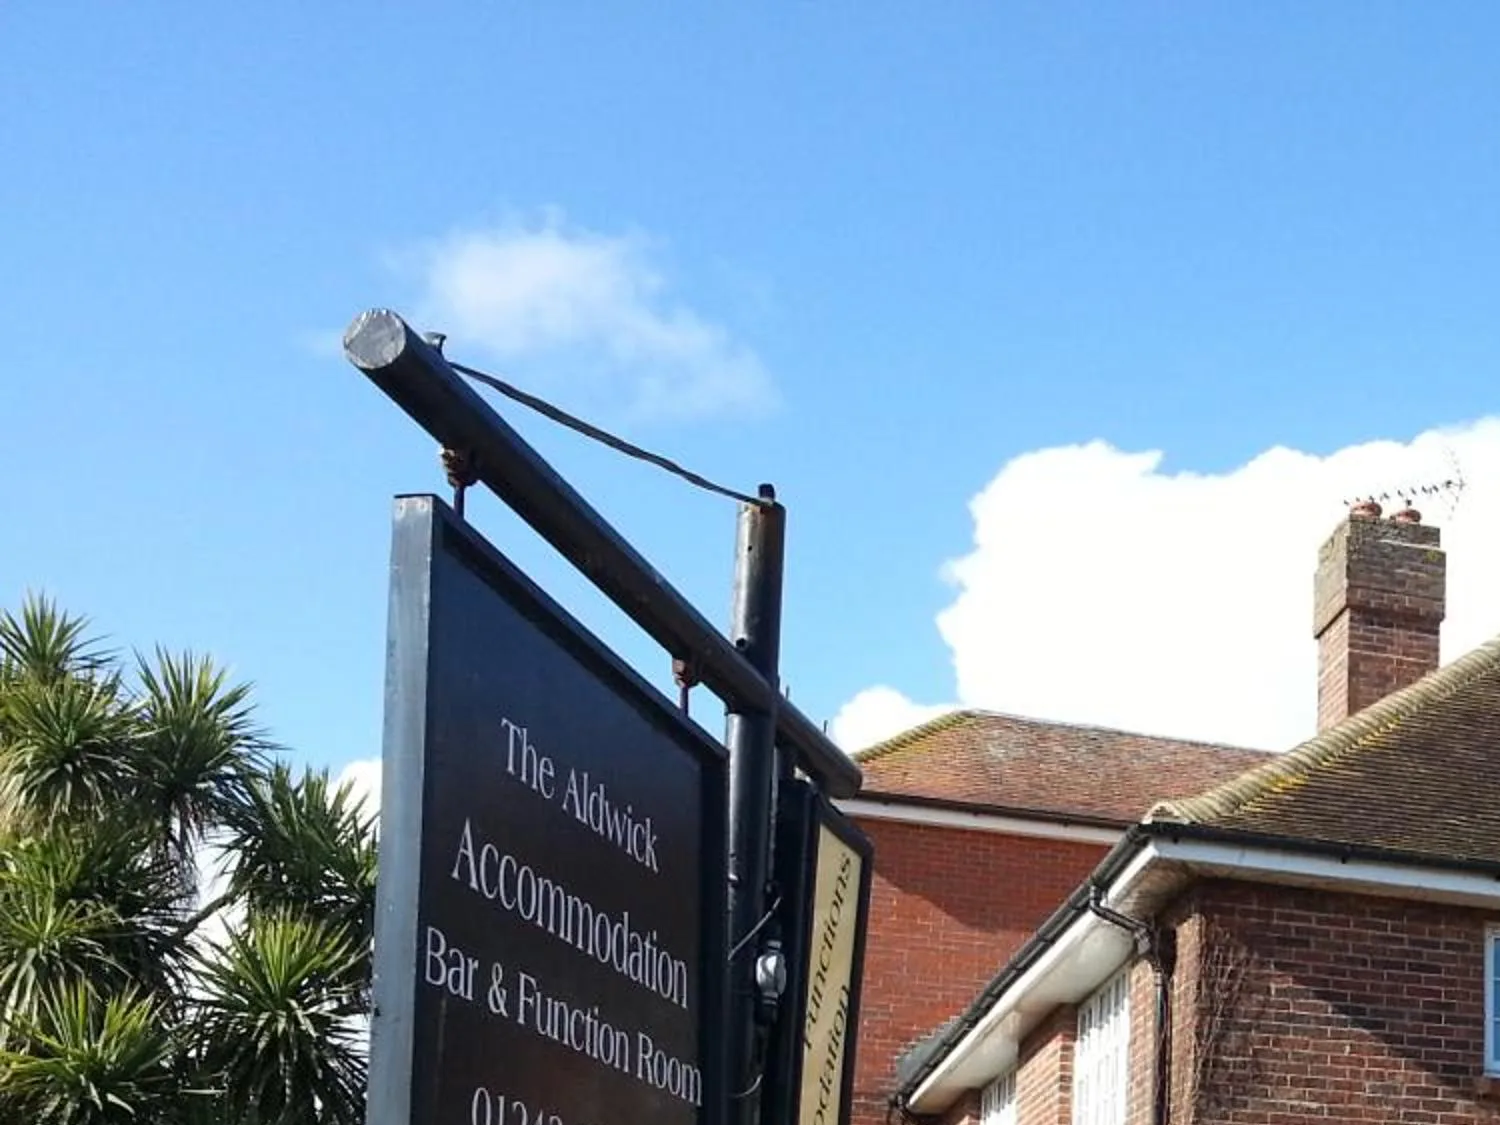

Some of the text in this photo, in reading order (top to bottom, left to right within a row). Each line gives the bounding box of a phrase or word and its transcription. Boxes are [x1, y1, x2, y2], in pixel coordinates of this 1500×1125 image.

[501, 717, 659, 874] The Aldwick
[450, 816, 689, 1010] Accommodation
[424, 925, 703, 1107] Bar & Function Room
